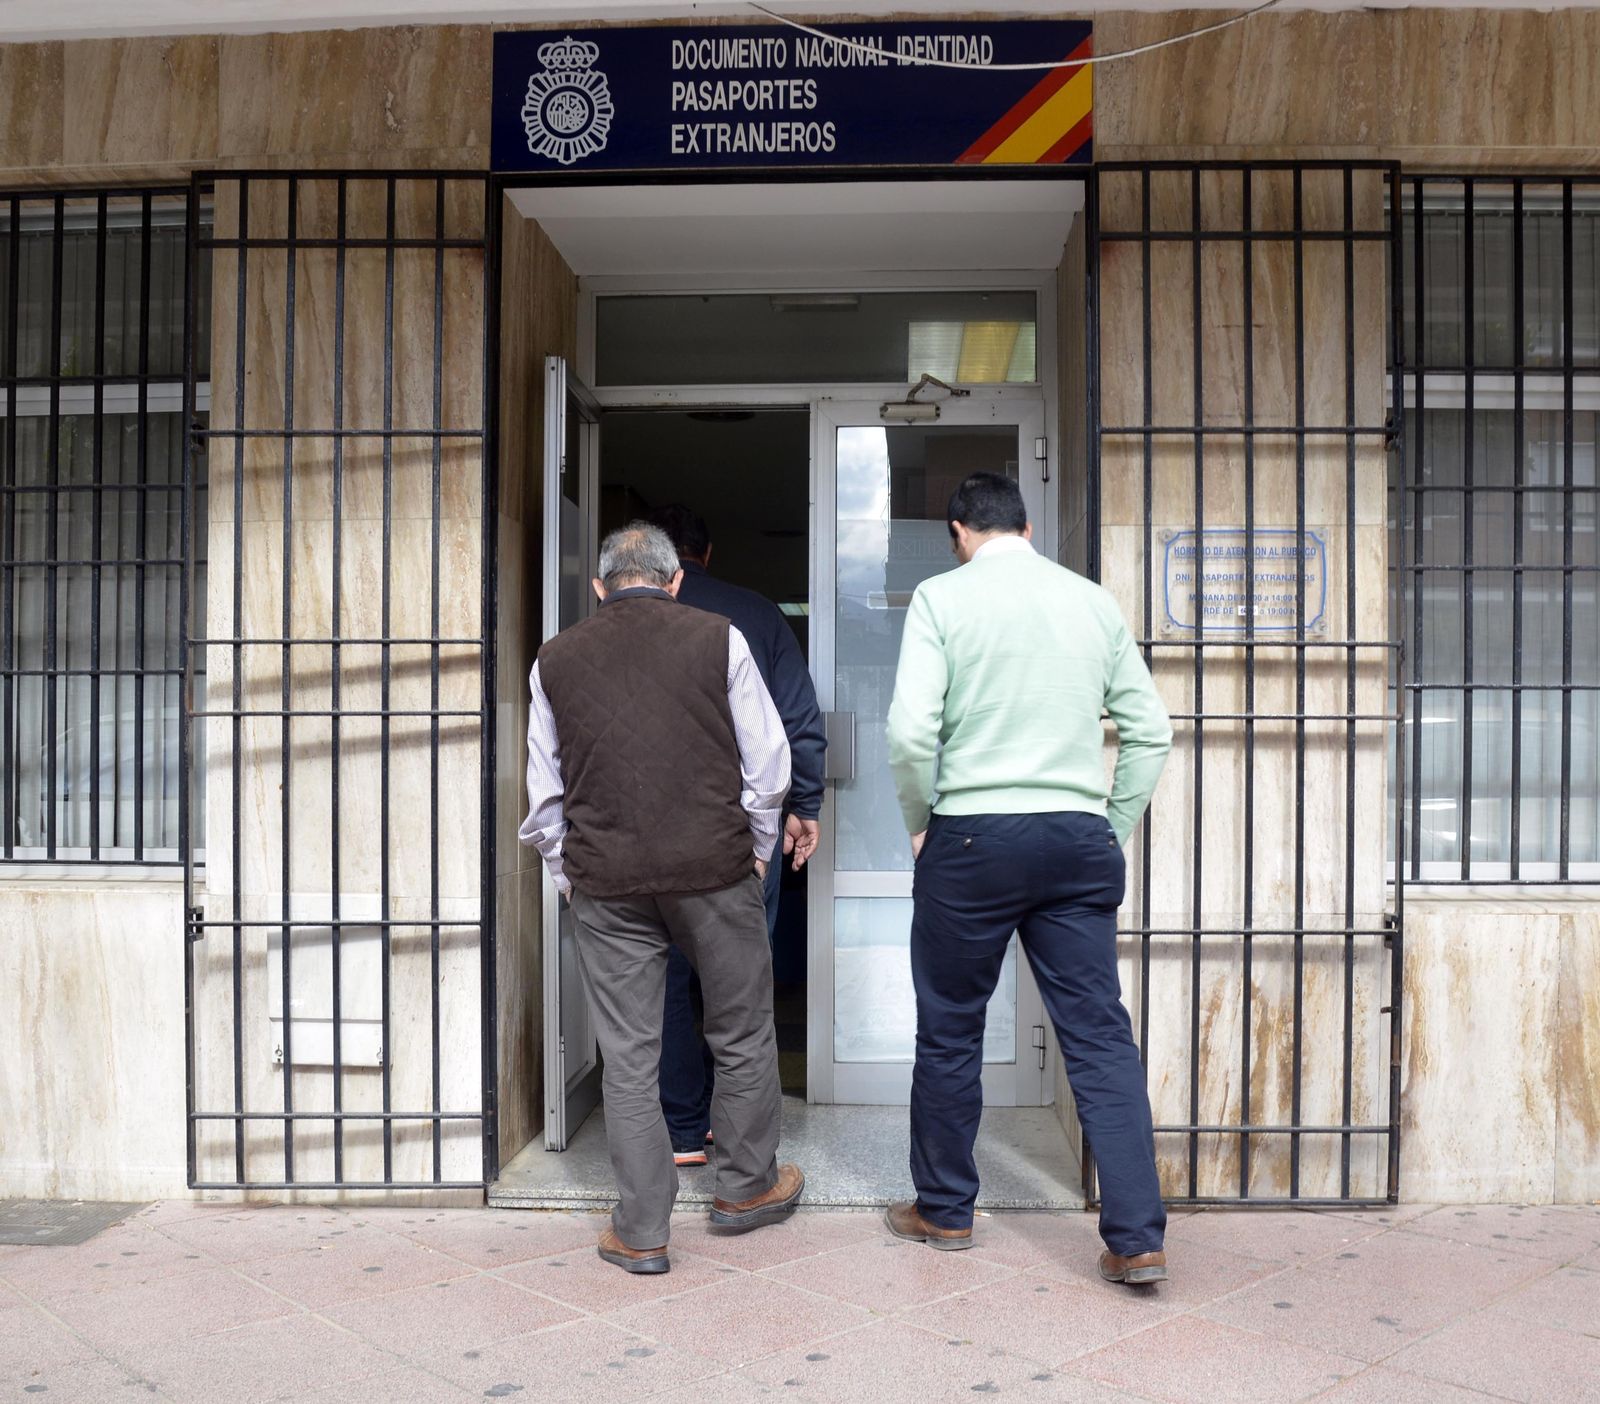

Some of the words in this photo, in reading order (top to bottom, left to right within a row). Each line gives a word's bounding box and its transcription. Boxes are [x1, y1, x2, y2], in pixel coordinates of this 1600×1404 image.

[672, 38, 787, 70] DOCUMENTO
[795, 36, 888, 68] NACIONAL
[897, 35, 994, 67] IDENTIDAD
[672, 79, 818, 111] PASAPORTES
[671, 121, 836, 154] EXTRANJEROS
[1174, 546, 1211, 557] HORAIO
[1213, 546, 1224, 557] DE
[1226, 546, 1267, 557] ATENON
[1269, 546, 1279, 557] AL
[1281, 546, 1317, 557] PUBCO
[1255, 573, 1315, 582] EXTRANJEOS
[1223, 607, 1234, 615] DE
